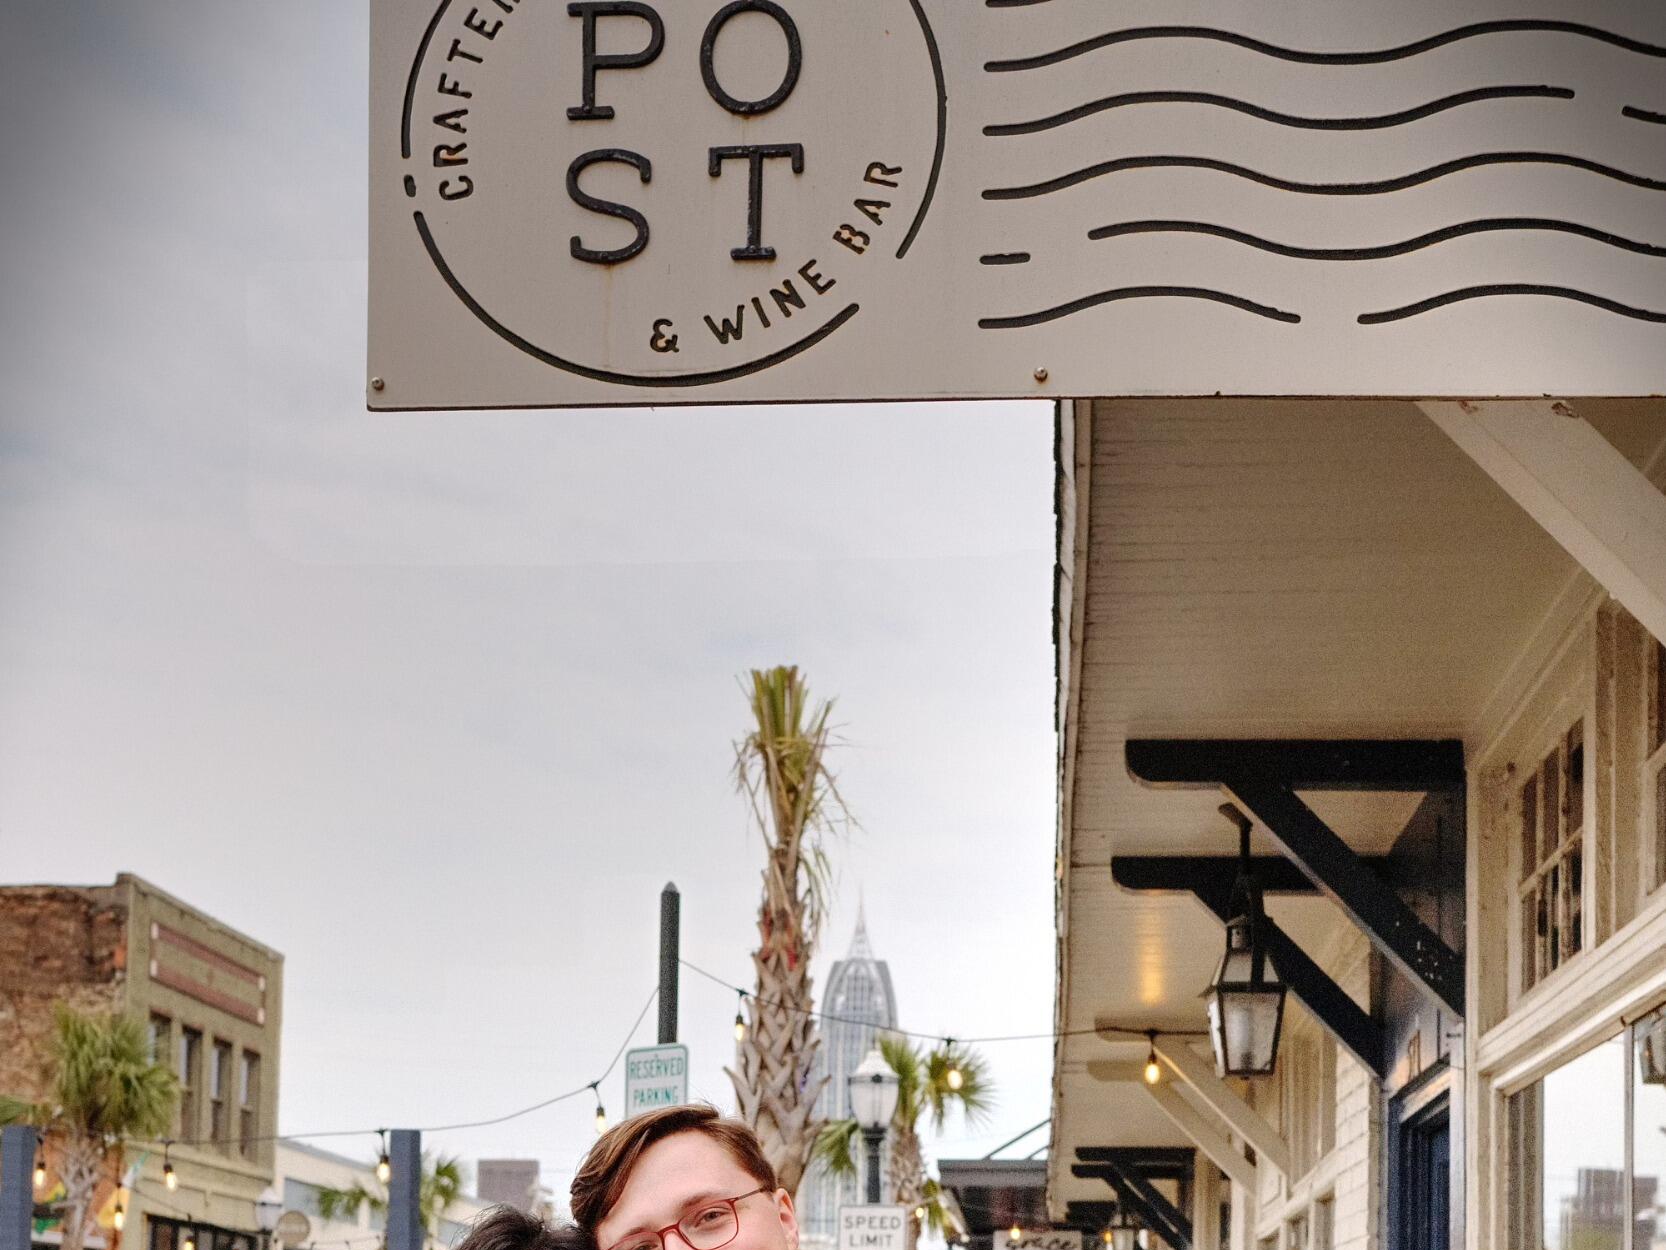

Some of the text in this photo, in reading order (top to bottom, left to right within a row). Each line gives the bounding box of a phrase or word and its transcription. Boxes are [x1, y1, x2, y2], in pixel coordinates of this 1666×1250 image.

[703, 259, 837, 345] WINE
[832, 160, 903, 255] BAR
[630, 1057, 684, 1079] RESERVED
[633, 1085, 679, 1108] PARKING
[844, 1215, 902, 1231] SPEED
[849, 1233, 894, 1248] LIMIT
